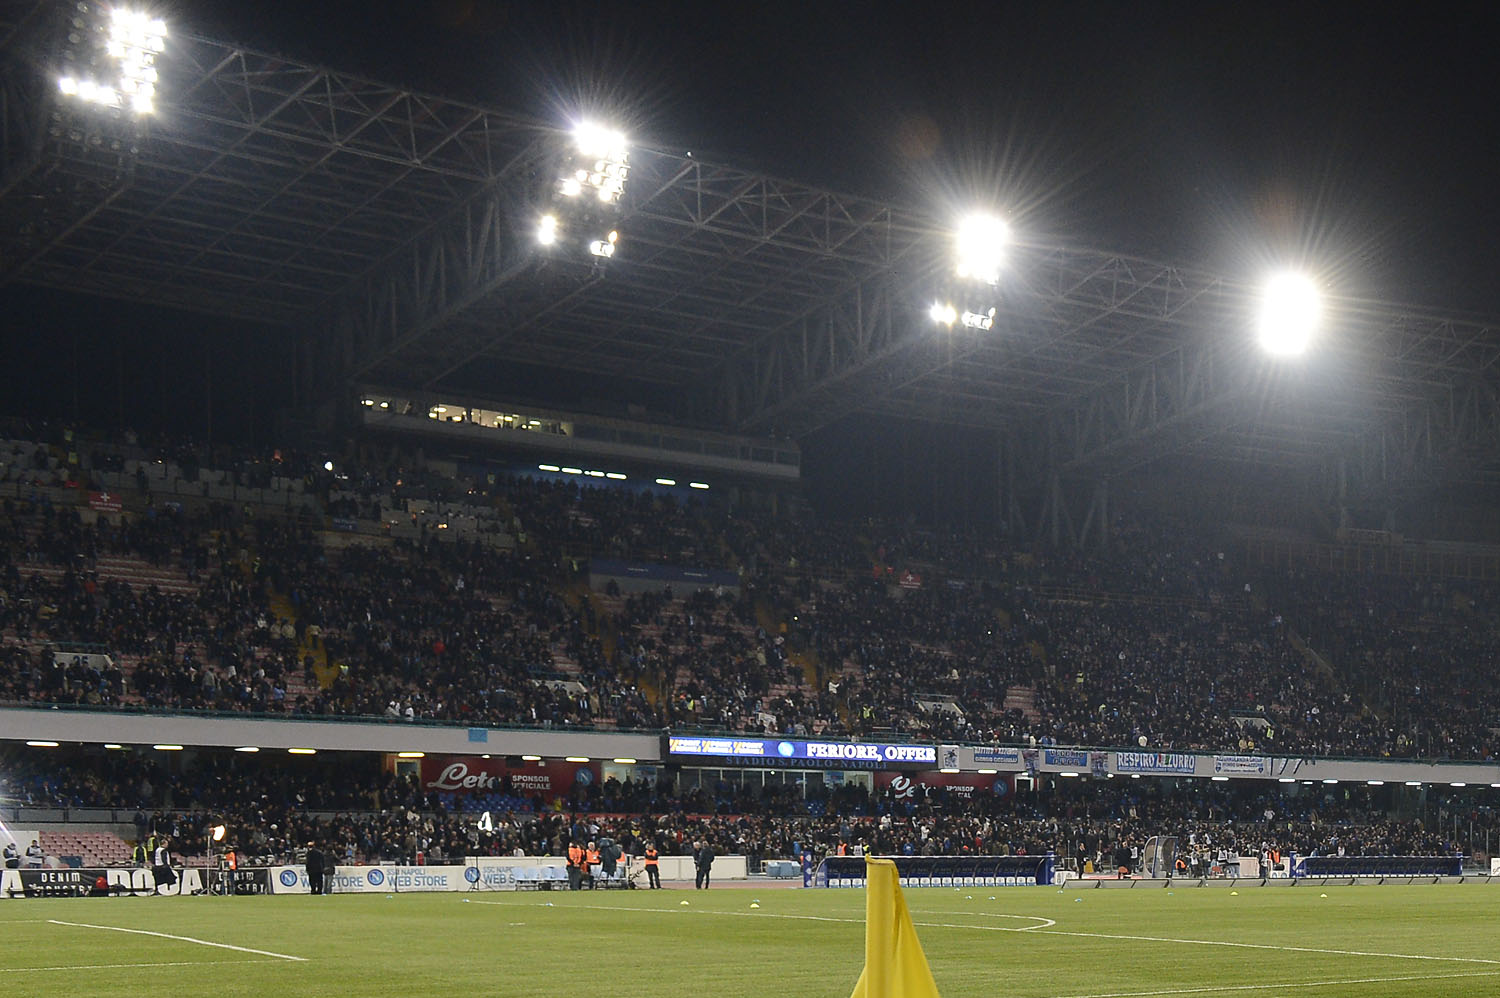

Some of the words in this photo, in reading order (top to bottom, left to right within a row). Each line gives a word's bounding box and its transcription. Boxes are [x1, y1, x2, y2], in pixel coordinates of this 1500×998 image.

[807, 743, 883, 761] FERIORE,
[884, 747, 936, 761] OFFER
[726, 757, 775, 766] STADIO
[1118, 753, 1154, 767] RESPIRO
[41, 872, 80, 883] DENIM
[218, 871, 254, 881] DNIM
[387, 876, 412, 886] WEB
[414, 877, 448, 886] STORE
[484, 875, 505, 884] WEB
